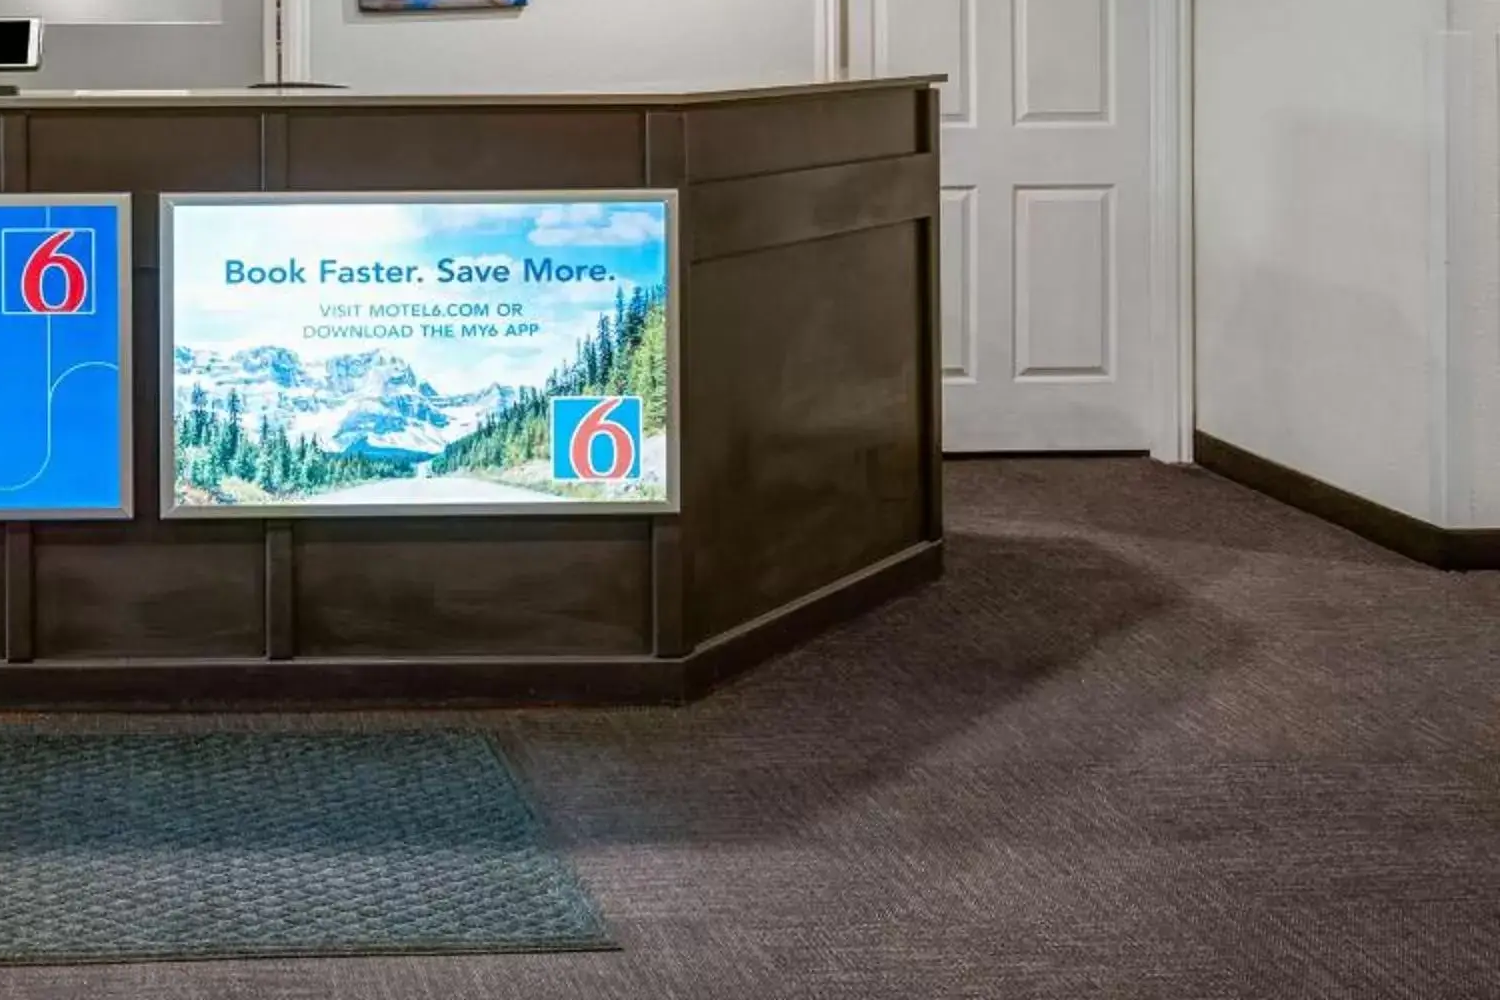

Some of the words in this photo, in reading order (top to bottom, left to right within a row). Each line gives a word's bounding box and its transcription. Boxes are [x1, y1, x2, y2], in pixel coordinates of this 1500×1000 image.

[20, 228, 88, 313] 6
[225, 257, 307, 285] Book
[319, 258, 425, 284] Faster.
[436, 257, 511, 283] Save
[522, 257, 617, 283] More.
[318, 303, 363, 318] VISIT
[368, 303, 490, 318] MOTEL6.COM
[496, 302, 525, 317] OR
[302, 324, 415, 340] DOWNLOAD
[419, 323, 456, 339] THE
[460, 323, 499, 338] MY6
[504, 322, 541, 338] APP
[569, 396, 635, 481] 6
